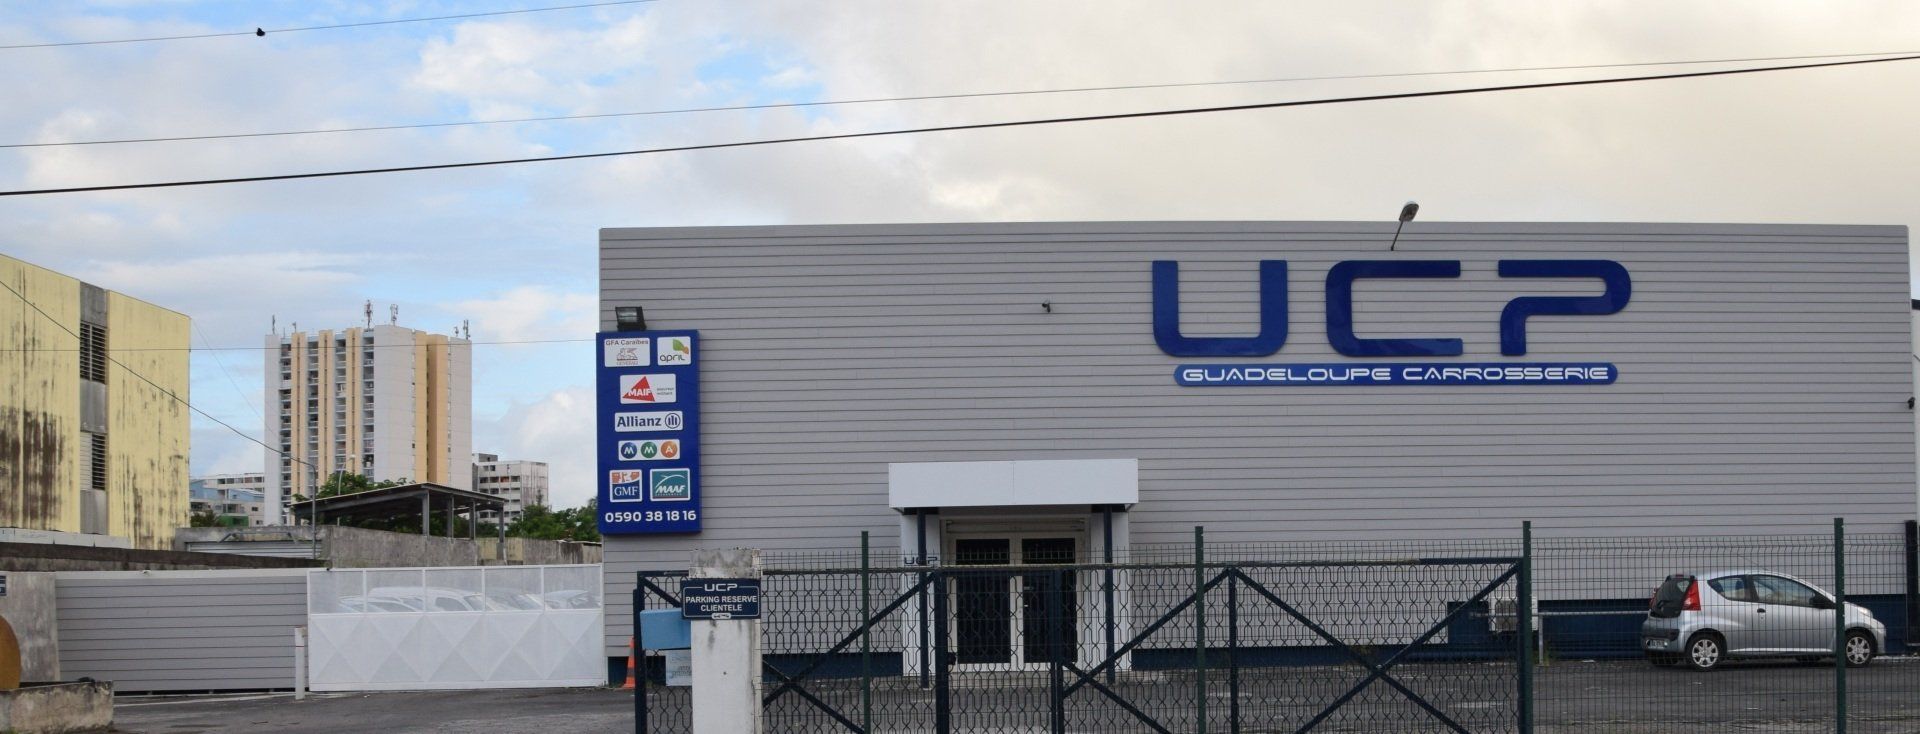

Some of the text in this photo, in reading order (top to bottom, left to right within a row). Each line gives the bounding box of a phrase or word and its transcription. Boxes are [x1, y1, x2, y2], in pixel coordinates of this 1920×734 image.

[1152, 260, 1631, 357] UCP
[659, 354, 685, 363] april
[1182, 367, 1609, 381] GUADELOUPE CARROSSERIE
[628, 388, 652, 397] MAIF
[617, 416, 662, 428] Allianz
[614, 486, 639, 496] GMF
[655, 485, 686, 494] MAAF
[605, 510, 697, 523] 0590 38 18 16
[704, 583, 738, 592] UCP
[685, 595, 758, 604] PARKING RESERVE
[700, 604, 743, 612] CLIENTELE
